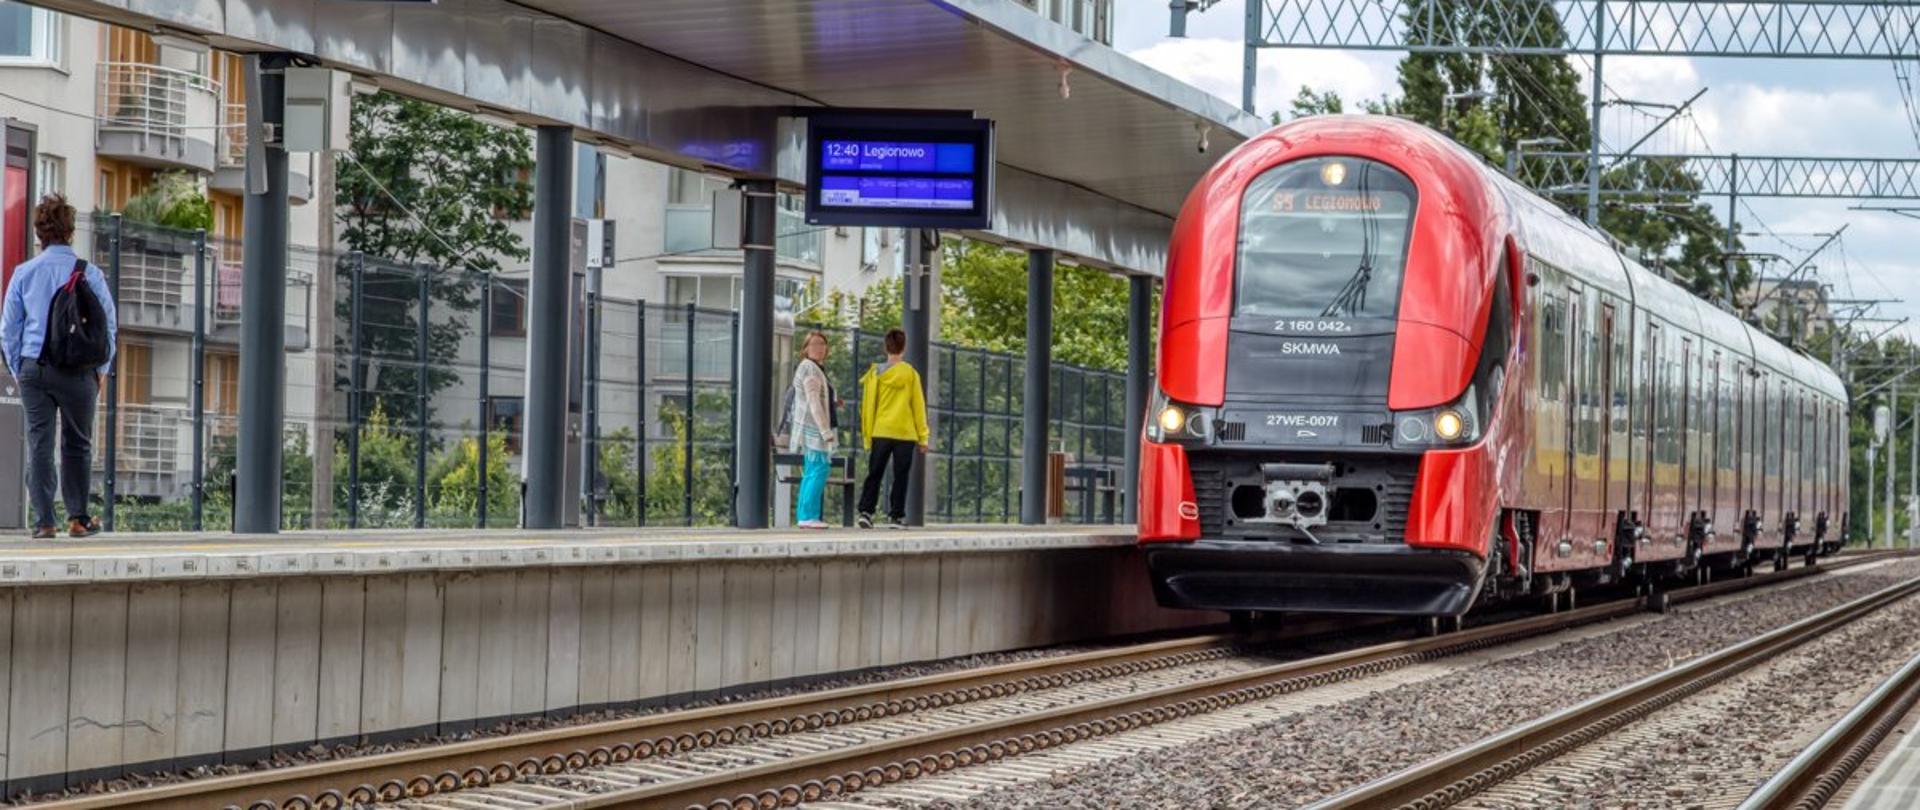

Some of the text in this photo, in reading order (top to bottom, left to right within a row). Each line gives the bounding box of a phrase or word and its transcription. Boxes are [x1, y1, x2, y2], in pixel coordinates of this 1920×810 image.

[827, 143, 924, 159] 12:40 Legionowo
[1274, 319, 1284, 331] 2
[1289, 320, 1314, 332] 160
[1282, 342, 1341, 355] SKMWA
